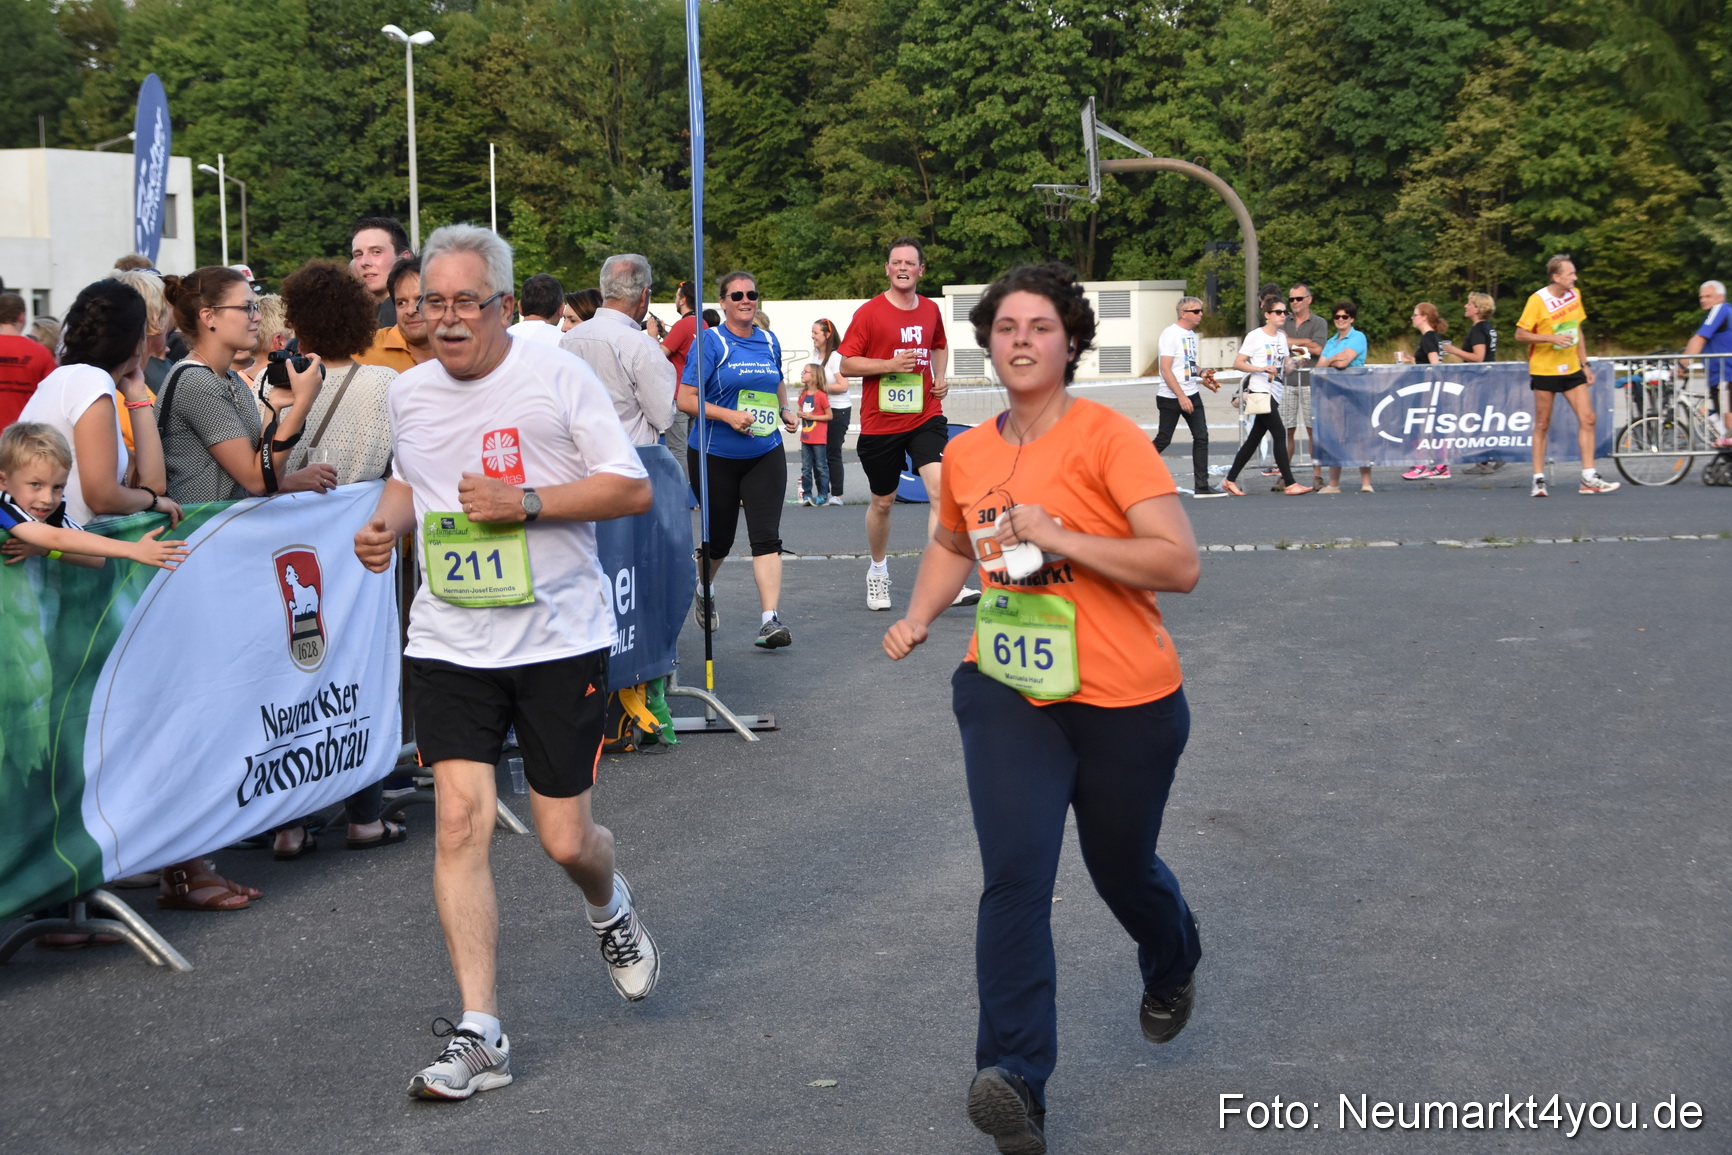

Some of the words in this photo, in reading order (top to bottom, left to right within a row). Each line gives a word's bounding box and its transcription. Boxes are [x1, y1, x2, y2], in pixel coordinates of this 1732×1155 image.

[900, 325, 923, 345] MRT
[888, 388, 913, 402] 961
[1403, 405, 1534, 434] Fische
[262, 443, 271, 470] SONY
[977, 507, 997, 525] 30
[436, 527, 469, 537] firmenlauf
[444, 548, 503, 581] 211
[443, 587, 488, 595] Hermann-Josef
[488, 585, 516, 593] Emonds
[297, 640, 319, 661] 1628
[993, 632, 1054, 670] 615
[1004, 672, 1028, 683] Manuela
[1029, 676, 1044, 684] Hauf
[260, 681, 360, 742] Neumarkter
